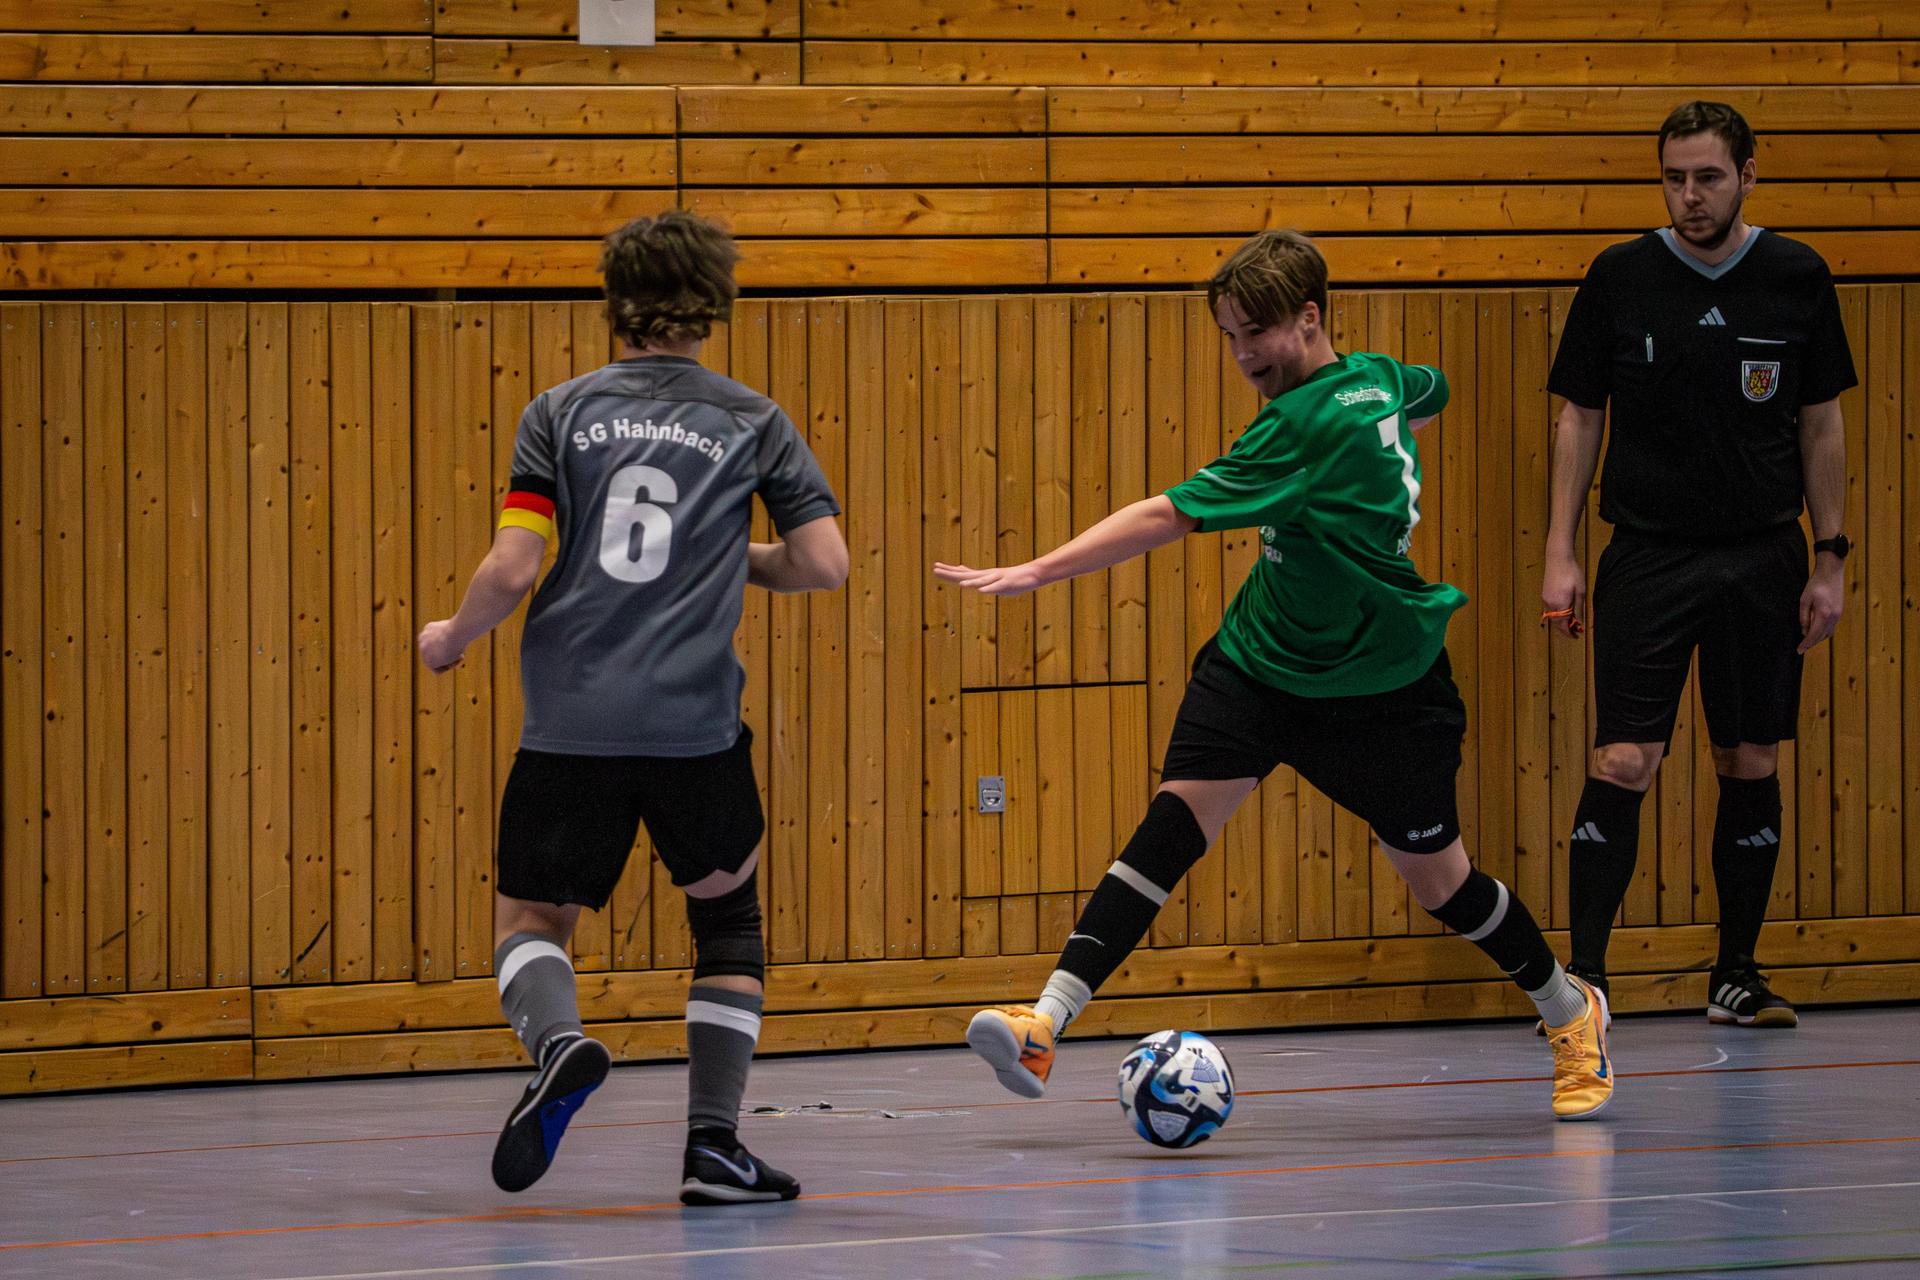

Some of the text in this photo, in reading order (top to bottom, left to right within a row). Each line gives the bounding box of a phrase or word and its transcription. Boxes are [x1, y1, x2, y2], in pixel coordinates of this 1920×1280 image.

[573, 418, 726, 463] SG Hahnbach
[598, 465, 678, 583] 6
